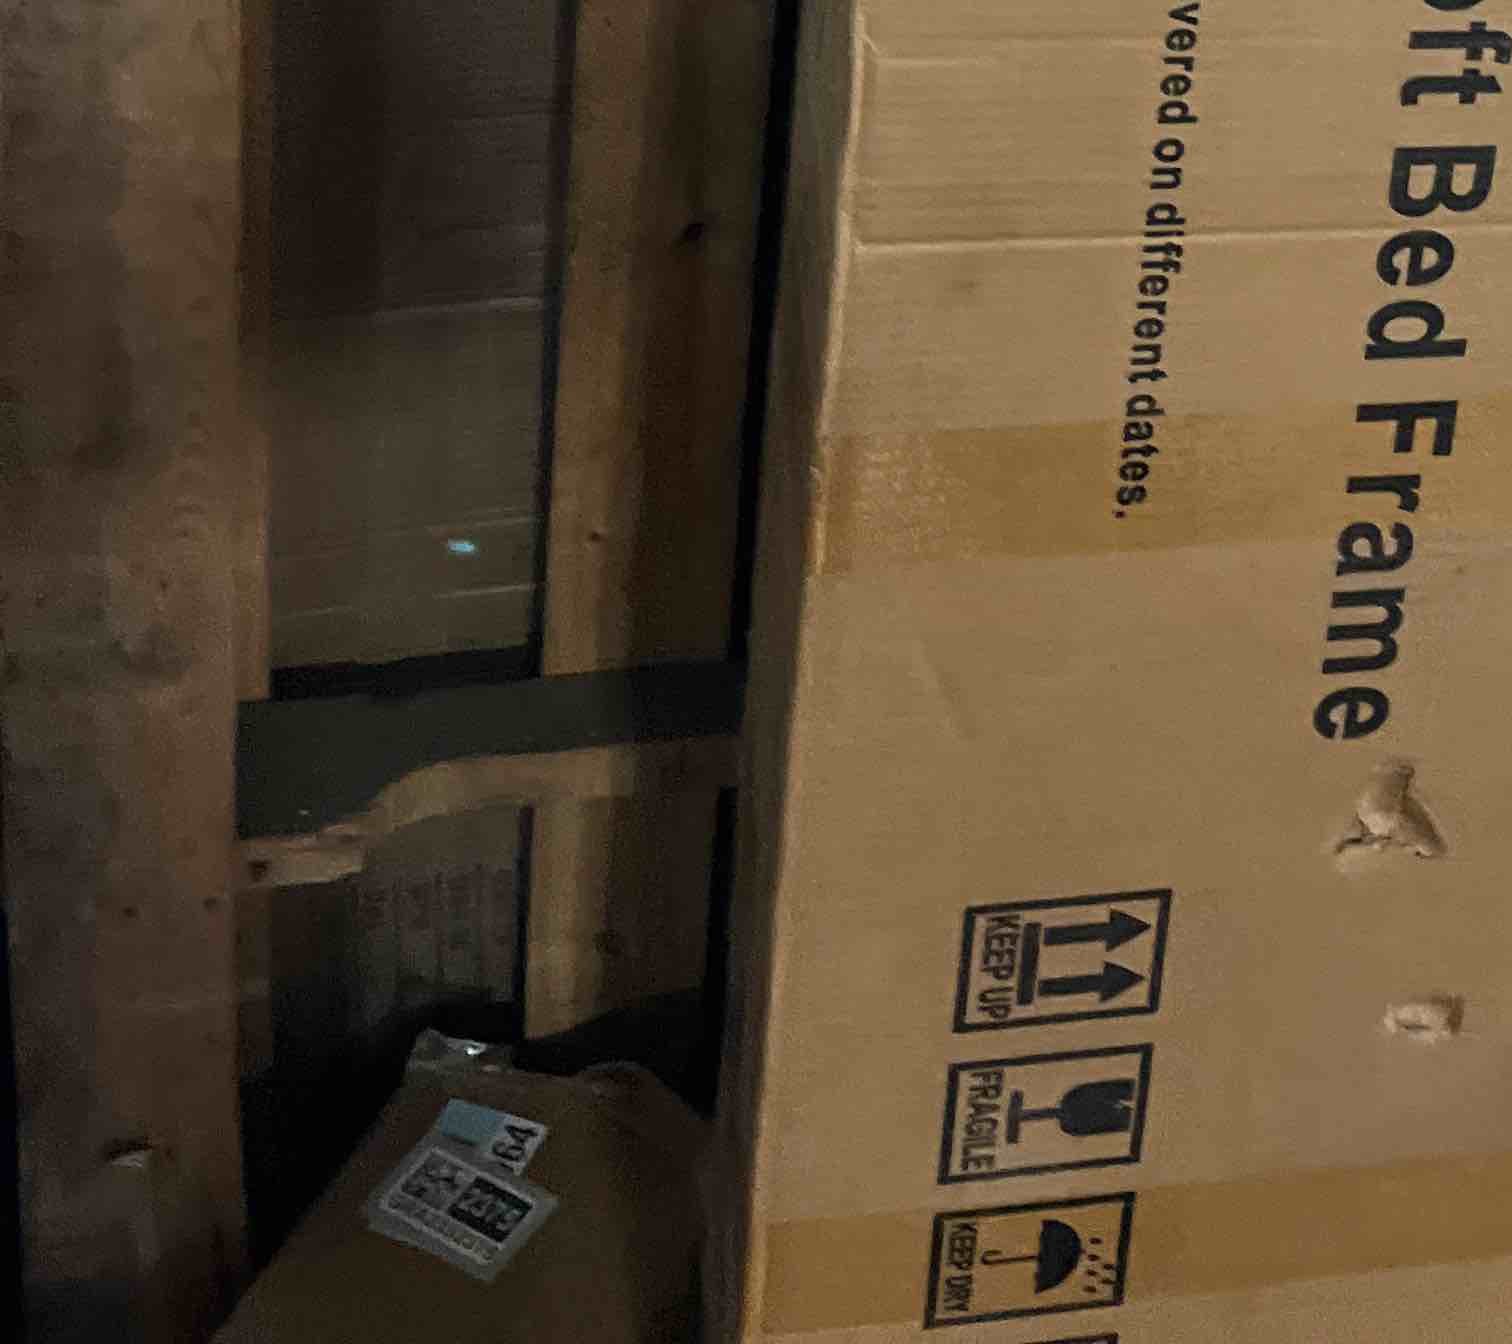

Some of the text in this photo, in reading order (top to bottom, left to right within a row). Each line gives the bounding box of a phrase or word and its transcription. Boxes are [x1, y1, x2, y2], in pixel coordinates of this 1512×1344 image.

[1143, 137, 1181, 190] on
[1121, 202, 1186, 383] different
[1364, 144, 1498, 361] Bed
[1104, 394, 1163, 518] dates.
[1313, 399, 1459, 741] Frame
[977, 914, 1020, 1020] KEEP UP
[960, 1070, 1003, 1173] FRAGILE
[944, 1219, 976, 1313] KEEP DRY
